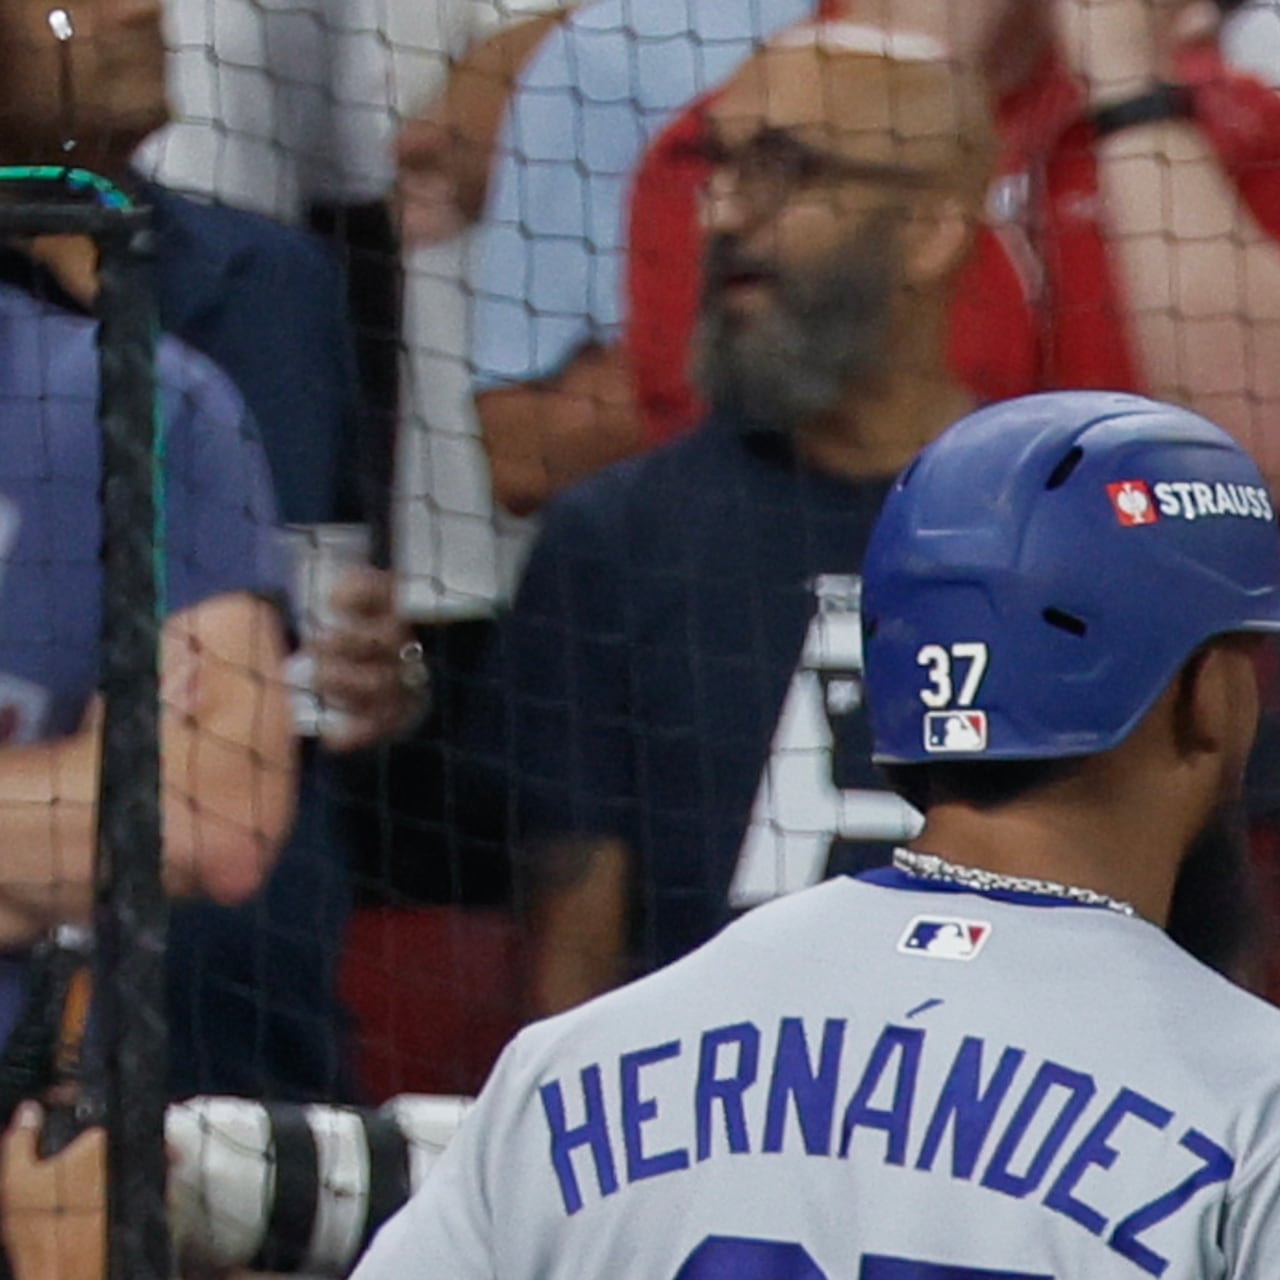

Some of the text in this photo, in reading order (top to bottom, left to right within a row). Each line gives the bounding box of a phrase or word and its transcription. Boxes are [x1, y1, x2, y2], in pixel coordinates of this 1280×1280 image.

[1152, 480, 1274, 523] STRAUSS
[916, 642, 988, 708] 37
[539, 998, 1235, 1279] HERNÁNDEZ
